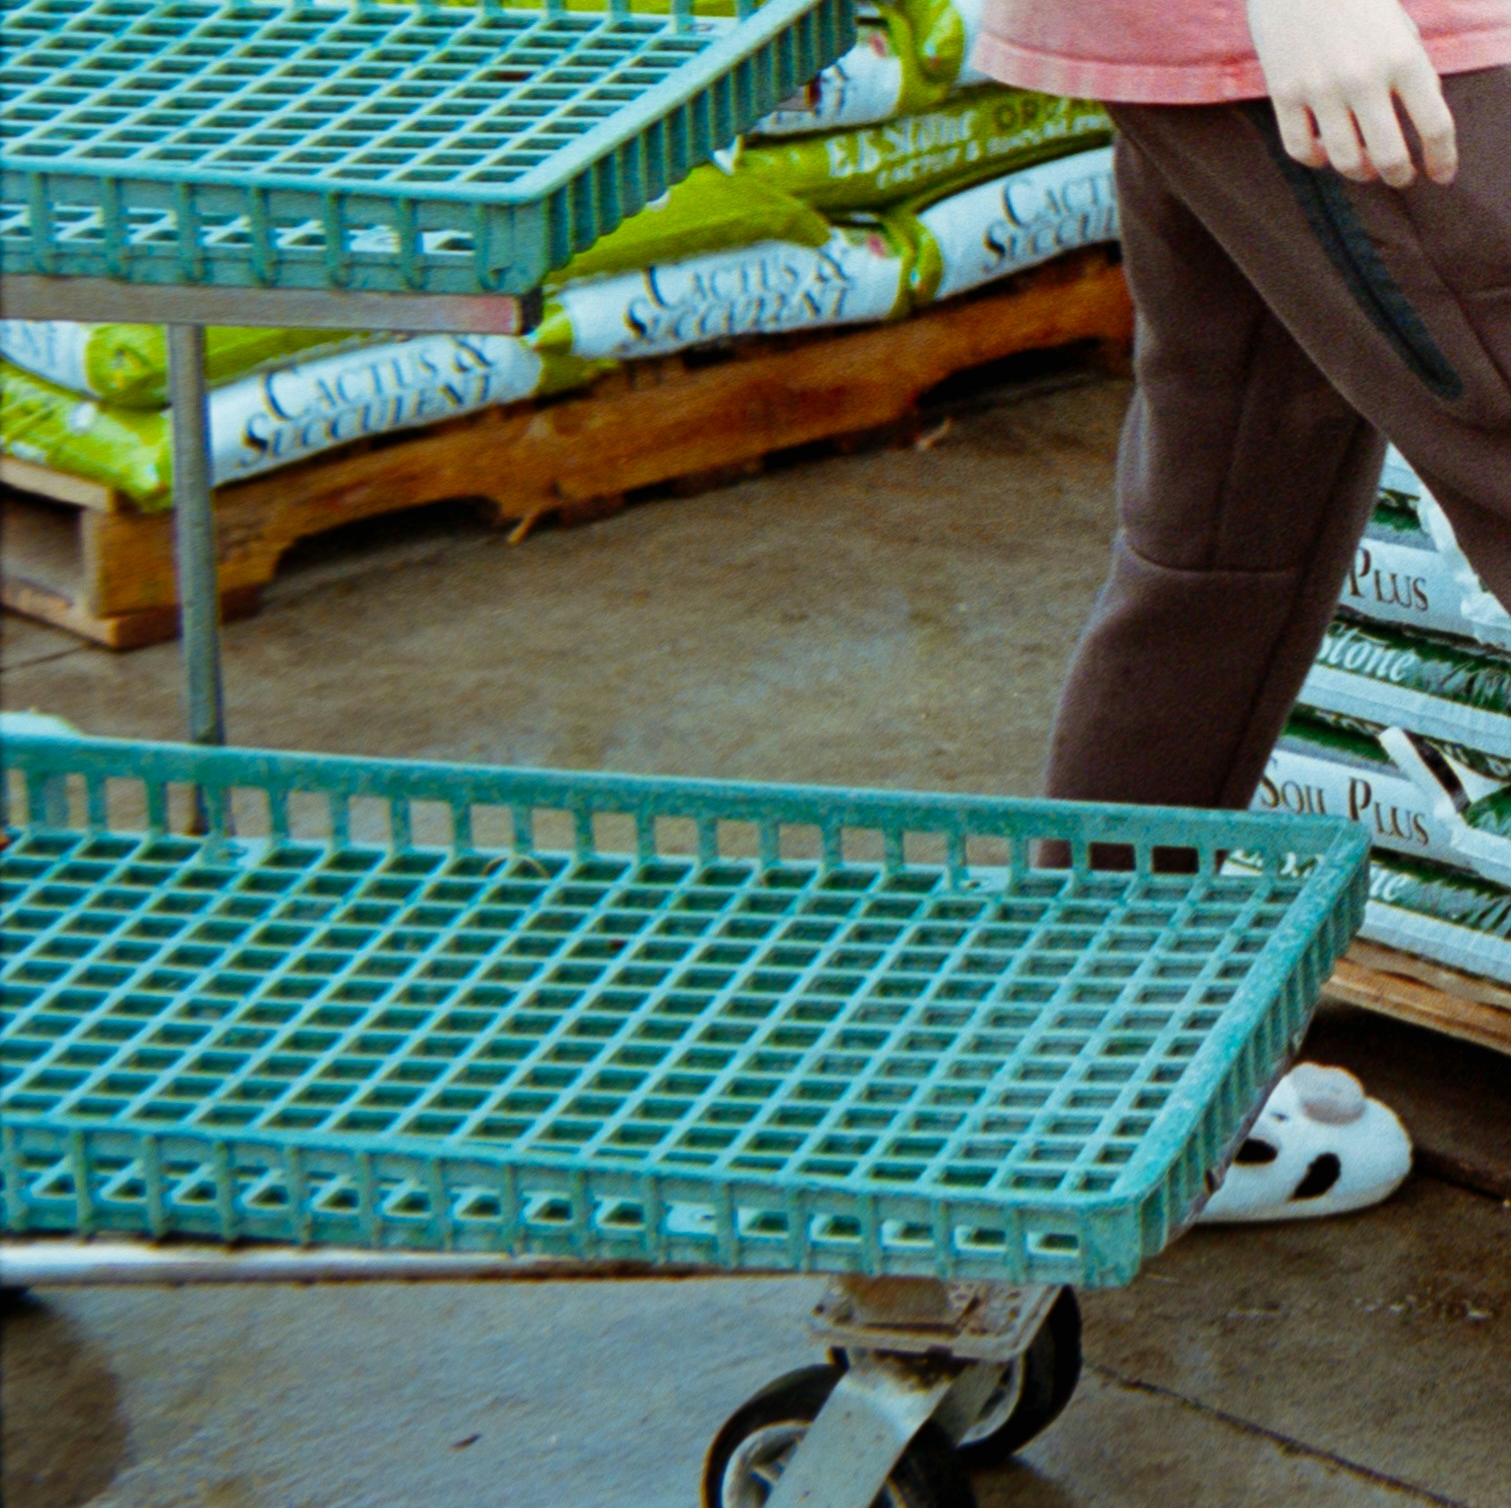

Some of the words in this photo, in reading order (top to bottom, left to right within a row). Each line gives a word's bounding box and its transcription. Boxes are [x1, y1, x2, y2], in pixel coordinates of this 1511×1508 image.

[1003, 172, 1117, 230] CACTU
[645, 253, 797, 309] CACTUS
[622, 288, 850, 349] SUCCULENT
[265, 351, 438, 422] CACTUS
[239, 377, 492, 469] SUCCULENT
[1349, 546, 1430, 612] PLUS
[1348, 775, 1430, 846] PLUS
